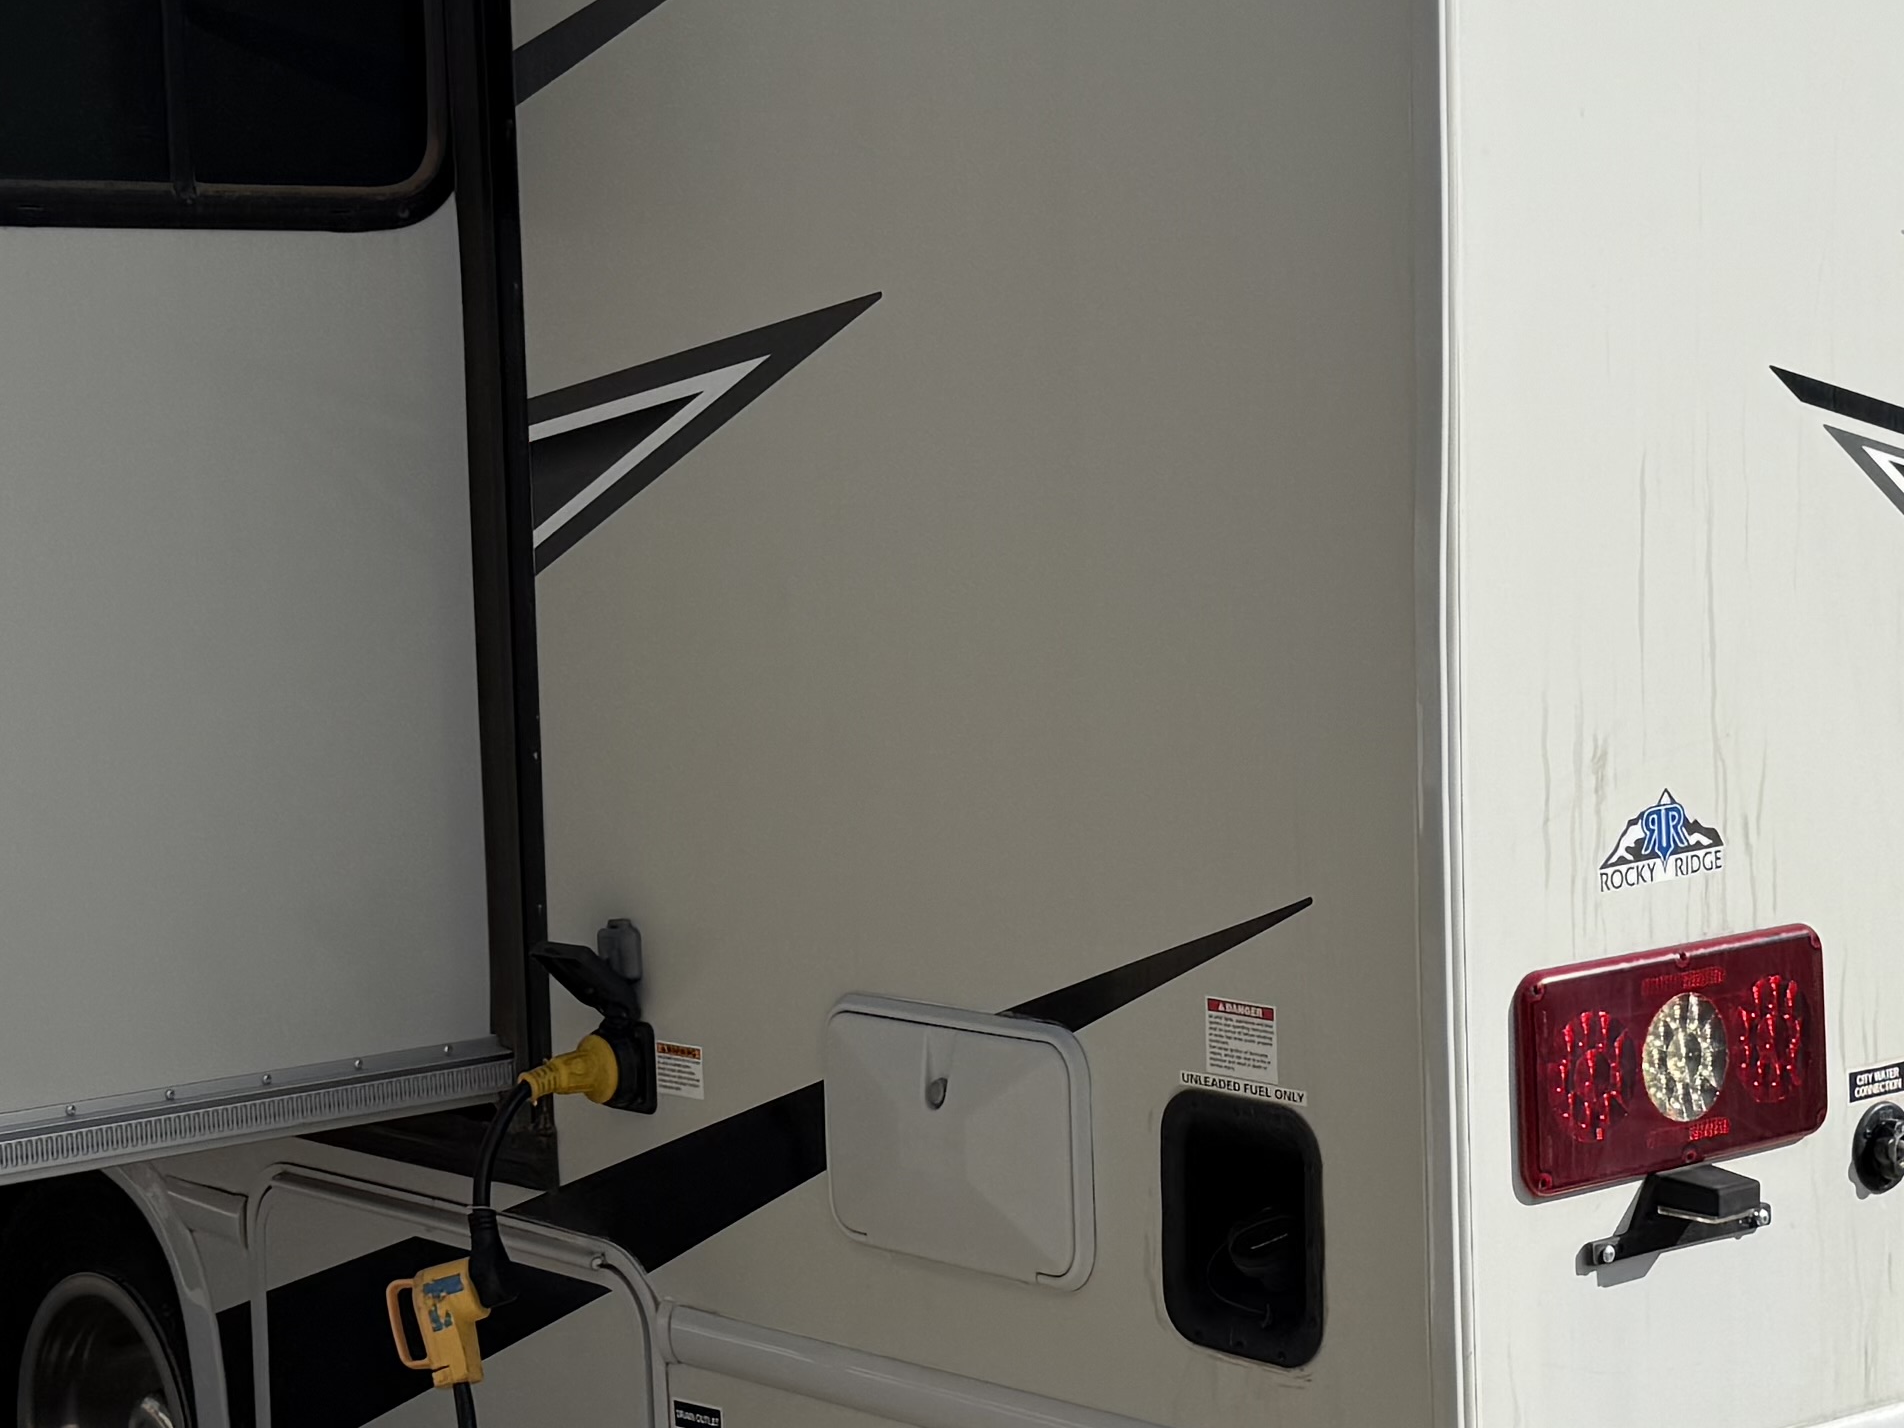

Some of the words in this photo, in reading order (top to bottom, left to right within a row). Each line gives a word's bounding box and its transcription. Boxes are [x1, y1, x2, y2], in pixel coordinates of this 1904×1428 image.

[1599, 863, 1656, 892] ROCKY
[1674, 850, 1722, 877] RIDGE
[1225, 1003, 1263, 1018] DANGER
[1856, 1073, 1874, 1086] CITY
[1874, 1067, 1900, 1082] WATER
[1181, 1072, 1241, 1092] UNLEADED
[1243, 1083, 1271, 1098] FUEL
[1274, 1089, 1305, 1104] ONLY
[1854, 1078, 1902, 1098] CONNECTION
